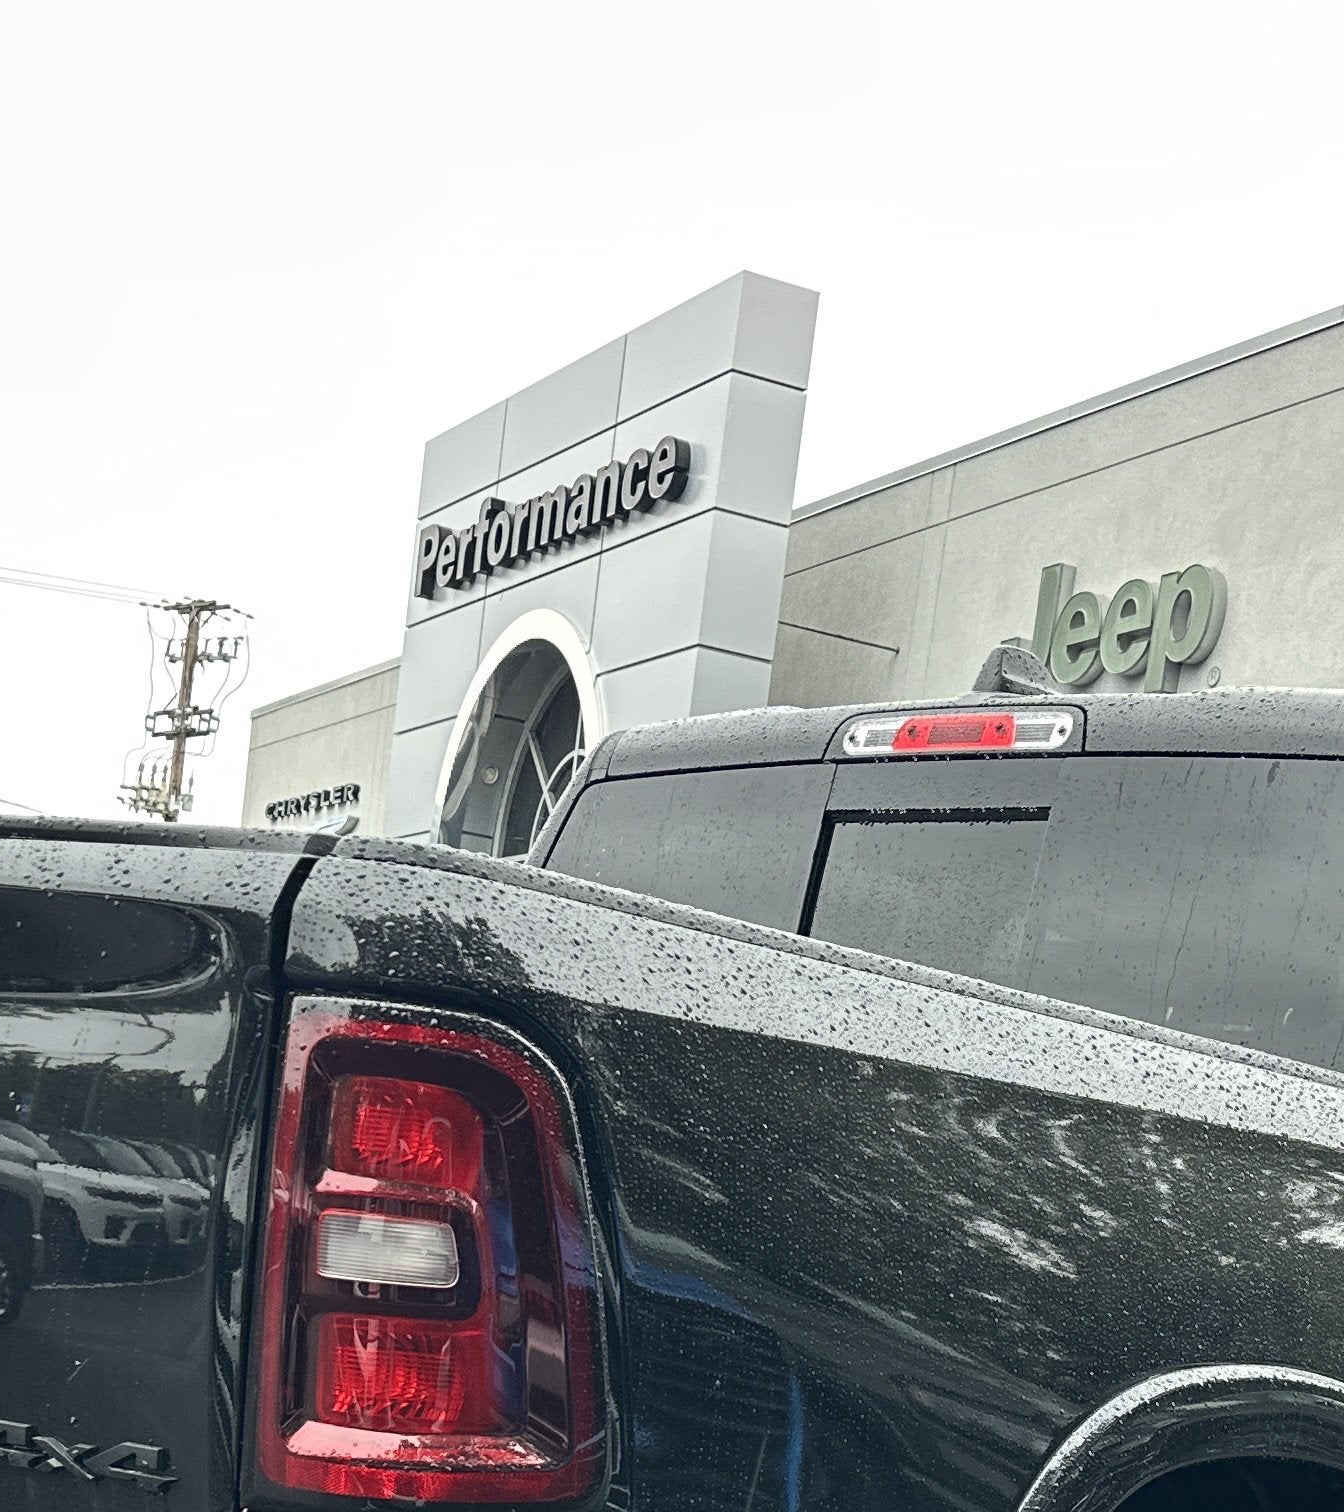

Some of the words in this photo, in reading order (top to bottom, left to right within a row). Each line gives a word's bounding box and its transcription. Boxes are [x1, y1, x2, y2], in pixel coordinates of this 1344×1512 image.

[414, 436, 690, 600] Performance
[1001, 563, 1227, 693] Jeep
[264, 783, 360, 821] CHRYSLER
